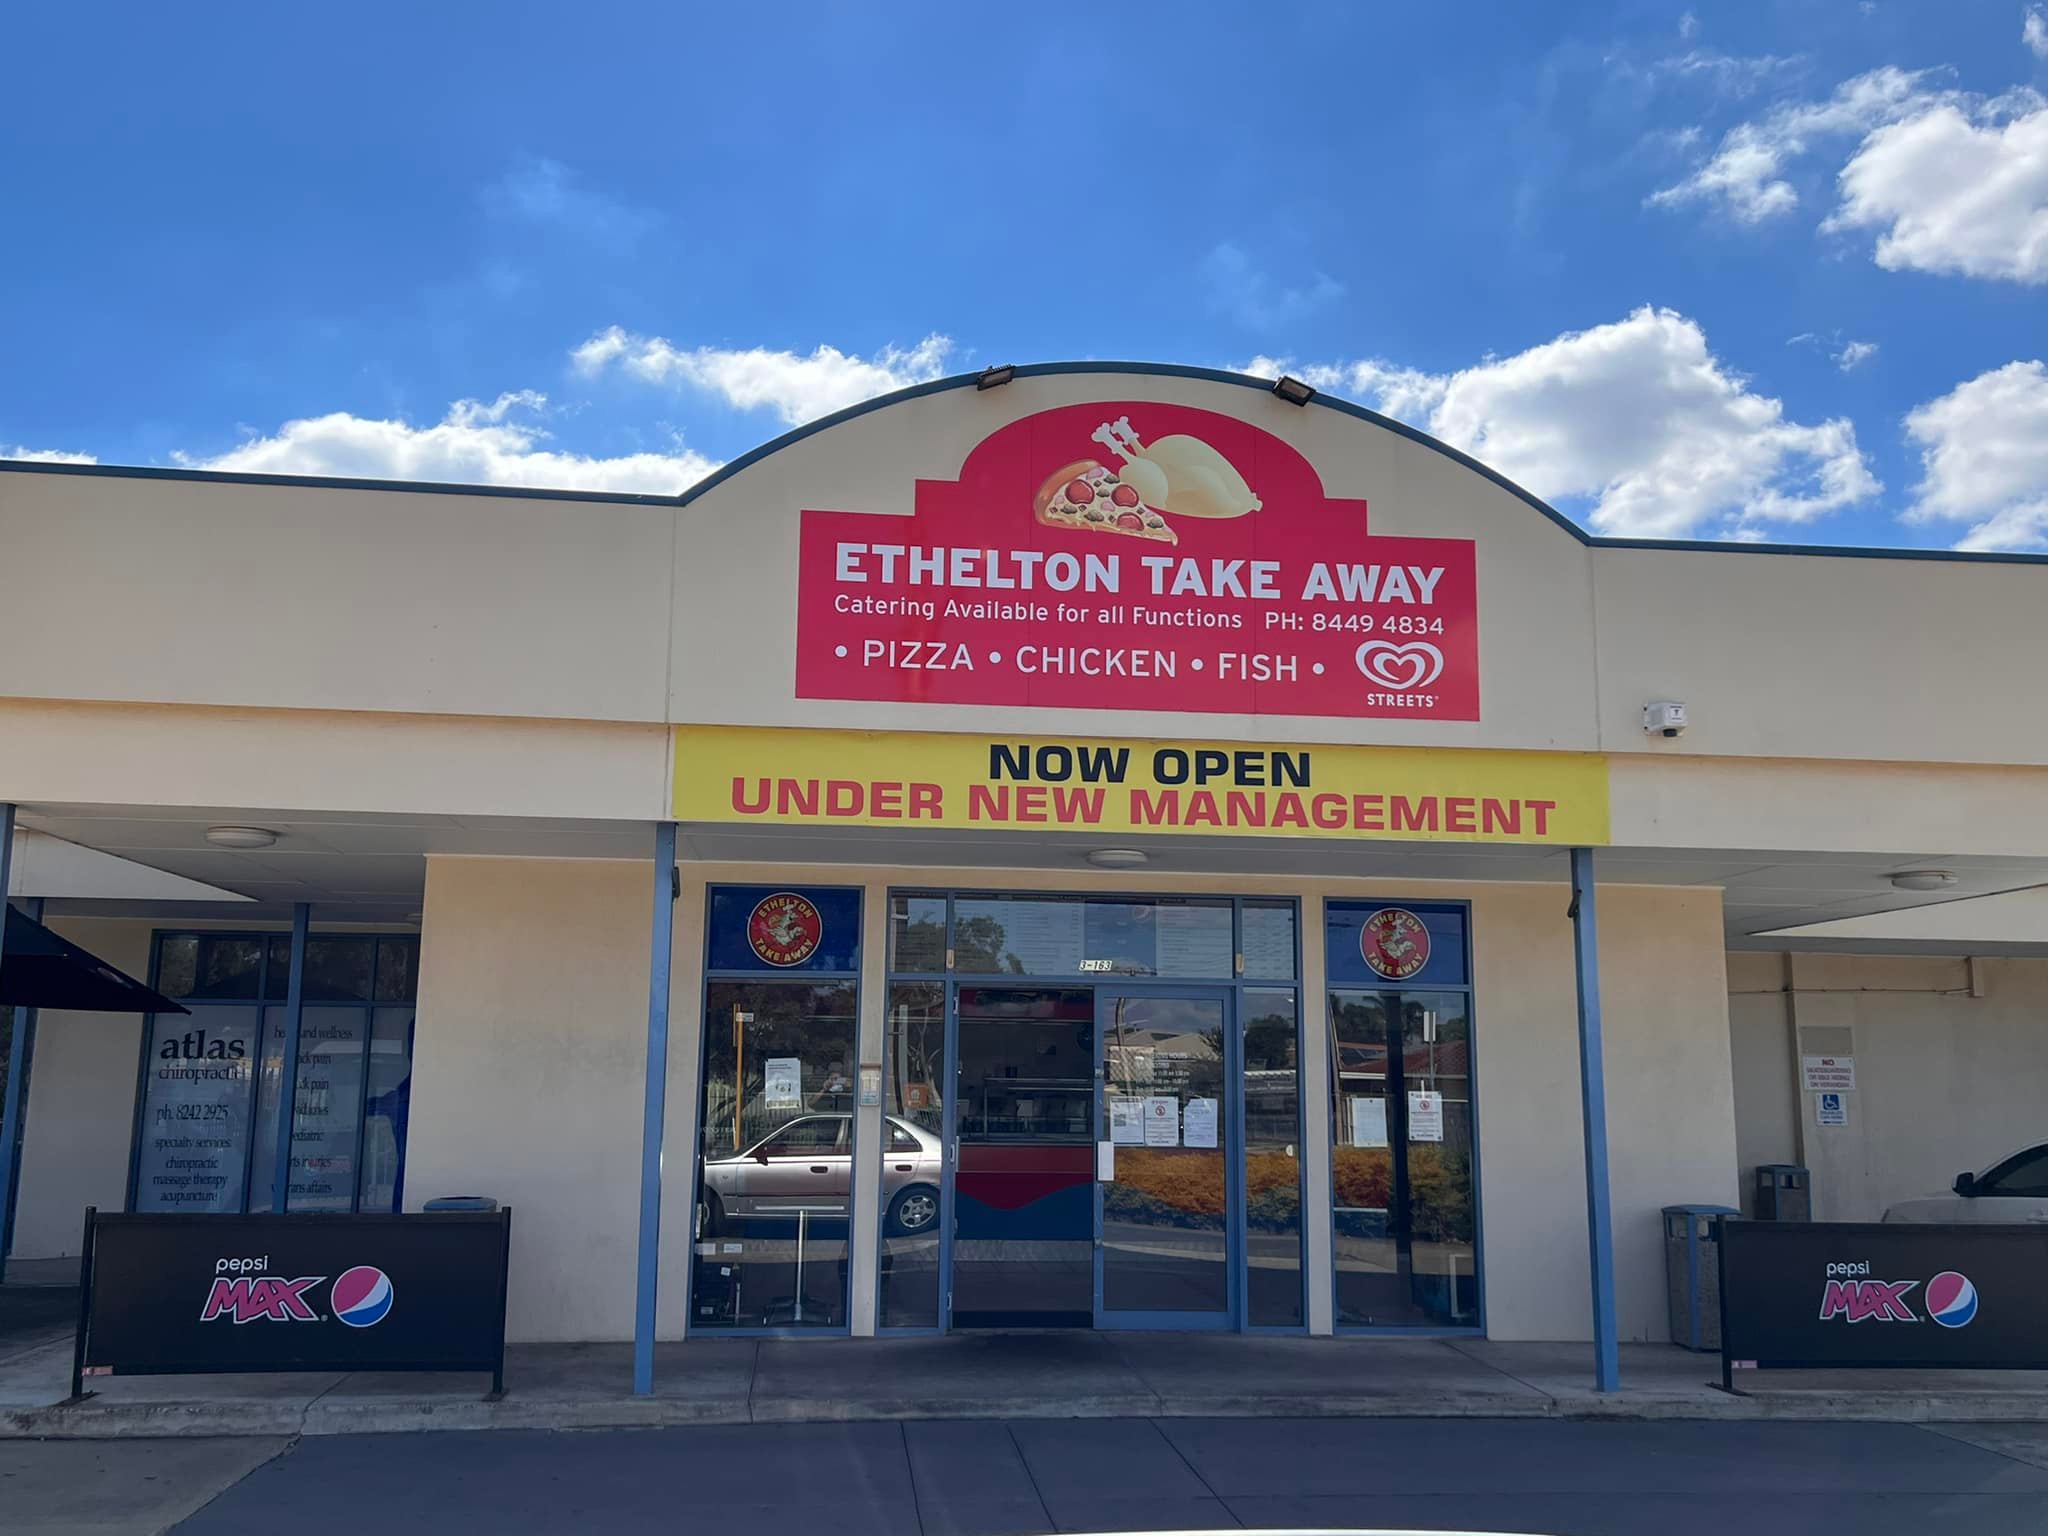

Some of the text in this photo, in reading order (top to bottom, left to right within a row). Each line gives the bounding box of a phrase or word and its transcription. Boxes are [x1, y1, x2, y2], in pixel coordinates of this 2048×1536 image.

[835, 542, 1445, 604] ETHELTON TAKE AWAY
[834, 594, 1444, 635] Catering Available for all Functions PH: 8449 4834
[862, 639, 1297, 682] PIZZA CHICKEN FISH
[1367, 693, 1434, 708] STREETS
[989, 744, 1311, 788] NOW OPEN
[732, 777, 1556, 836] UNDER NEW MANAGEMENT
[758, 898, 813, 918] ETHELTON
[755, 938, 813, 962] TAKE AWAY
[1368, 951, 1422, 976] TAKE AWAY
[160, 1029, 245, 1060] atlas
[176, 1104, 201, 1120] 8242
[165, 1155, 219, 1172] chiropractic
[153, 1172, 228, 1189] massage therapy
[216, 1255, 268, 1274] pepsi
[1826, 1260, 1870, 1277] pepsi
[200, 1277, 327, 1324] MAX
[1819, 1280, 1920, 1323] MAX
